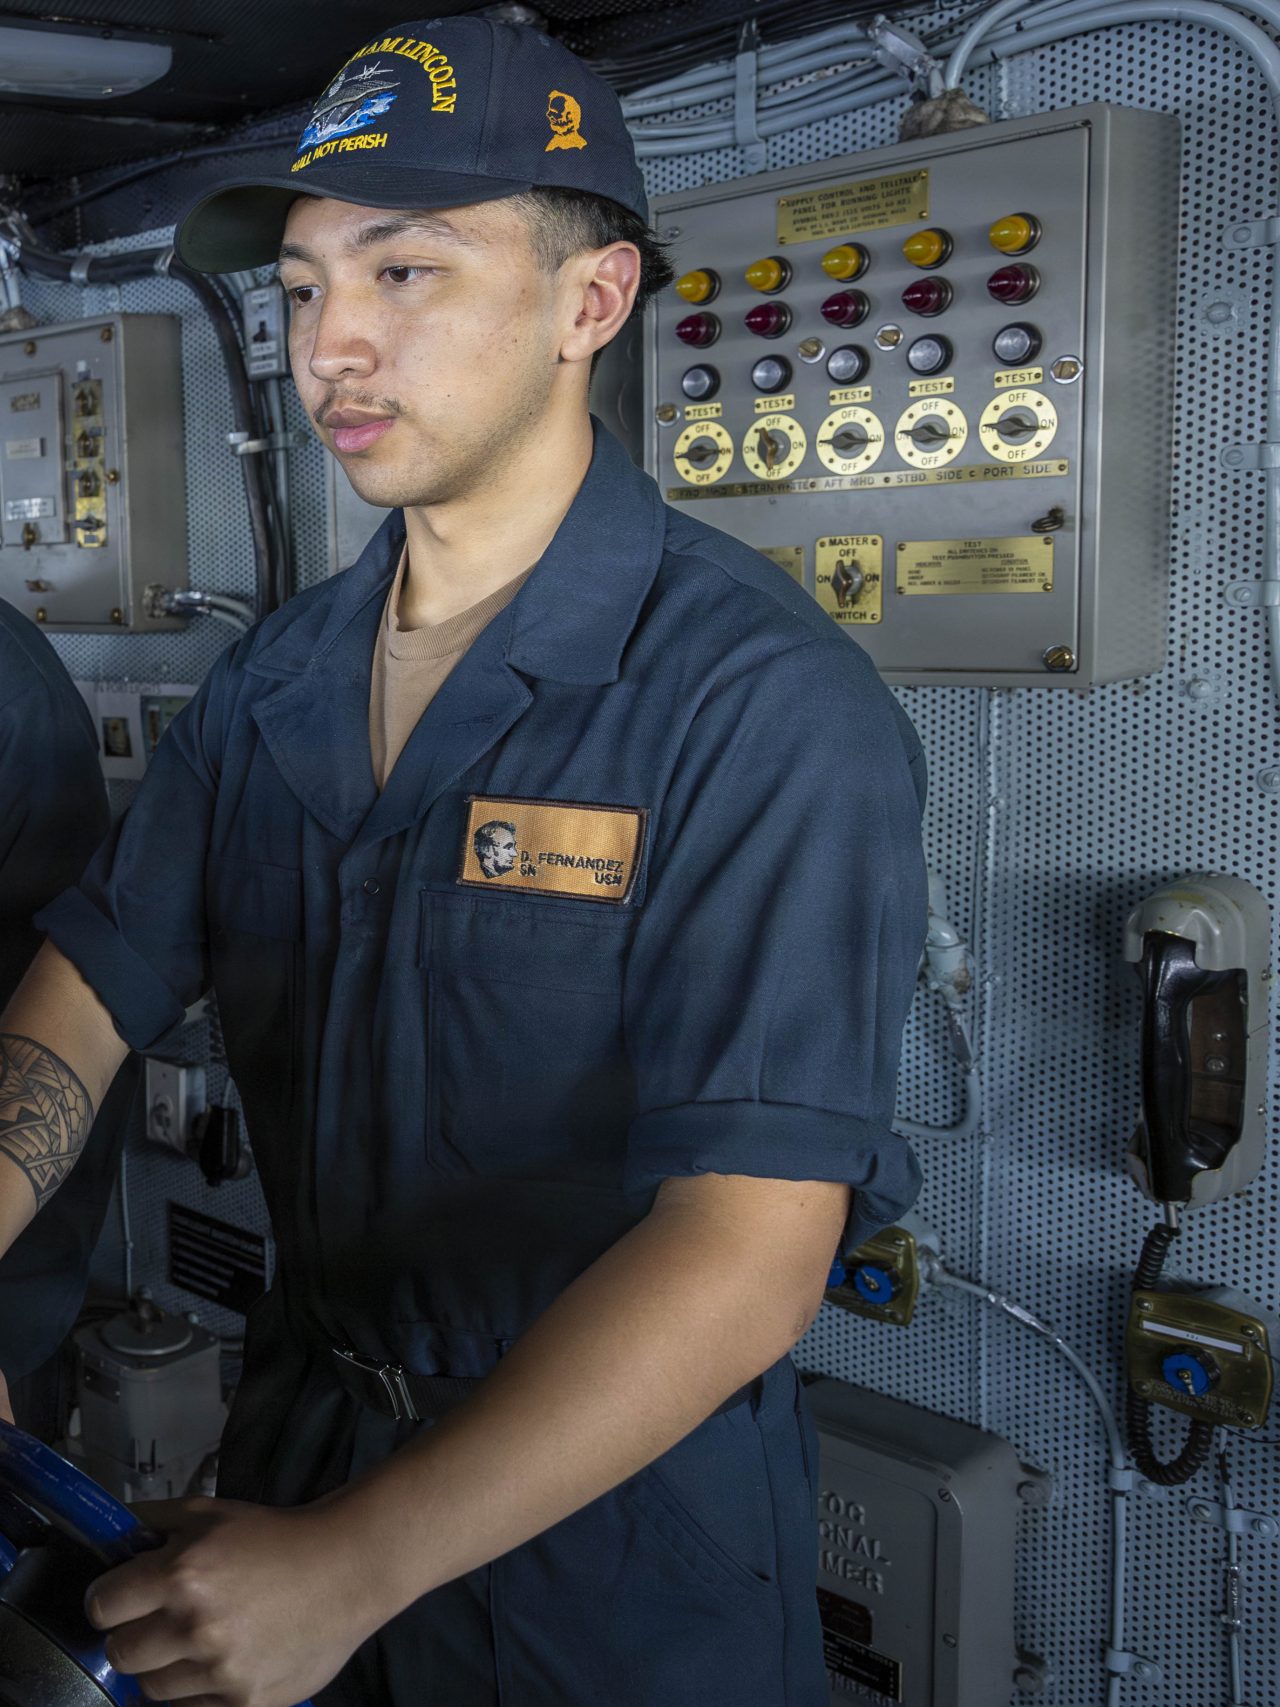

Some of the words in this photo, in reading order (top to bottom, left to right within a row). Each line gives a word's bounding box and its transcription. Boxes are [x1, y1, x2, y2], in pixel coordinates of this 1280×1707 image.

[394, 38, 457, 114] LINCOLN
[313, 140, 339, 160] NOT
[338, 133, 388, 153] PERISH
[786, 197, 814, 208] SUPPLY
[818, 189, 854, 201] CONTROL
[859, 183, 876, 193] AND
[793, 206, 817, 216] PANEL
[821, 202, 837, 211] FOR
[840, 194, 878, 207] RUNNING
[881, 186, 911, 199] LIGHTS
[1005, 372, 1034, 384] TEST
[918, 382, 945, 392] TEST
[838, 391, 863, 400] TEST
[1008, 393, 1028, 403] OFF
[763, 399, 787, 409] TEST
[922, 401, 940, 411] OFF
[692, 407, 715, 416] TEST
[841, 410, 858, 419] OFF
[766, 418, 782, 426] OFF
[1040, 419, 1055, 429] ON
[696, 424, 710, 433] OFF
[952, 427, 965, 437] ON
[744, 446, 756, 454] ON
[792, 441, 804, 450] ON
[720, 448, 732, 456] ON
[1008, 450, 1026, 459] OFF
[921, 457, 939, 466] OFF
[766, 468, 781, 477] OFF
[841, 463, 858, 472] OFF
[984, 466, 1015, 477] PORT
[1024, 464, 1052, 475] SIDE
[696, 474, 711, 482] OFF
[936, 471, 963, 481] SIDE
[824, 479, 844, 489] AFT
[850, 477, 875, 486] MHD
[829, 537, 869, 546] MASTER
[839, 549, 857, 557] OFF
[816, 574, 831, 583] ON
[865, 574, 880, 582] ON
[520, 850, 532, 862] D.
[538, 852, 624, 873] FERNANDEZ
[520, 864, 537, 877] SN
[594, 872, 623, 886] USN
[819, 1520, 892, 1566] GNAL
[819, 1550, 883, 1595] IMER
